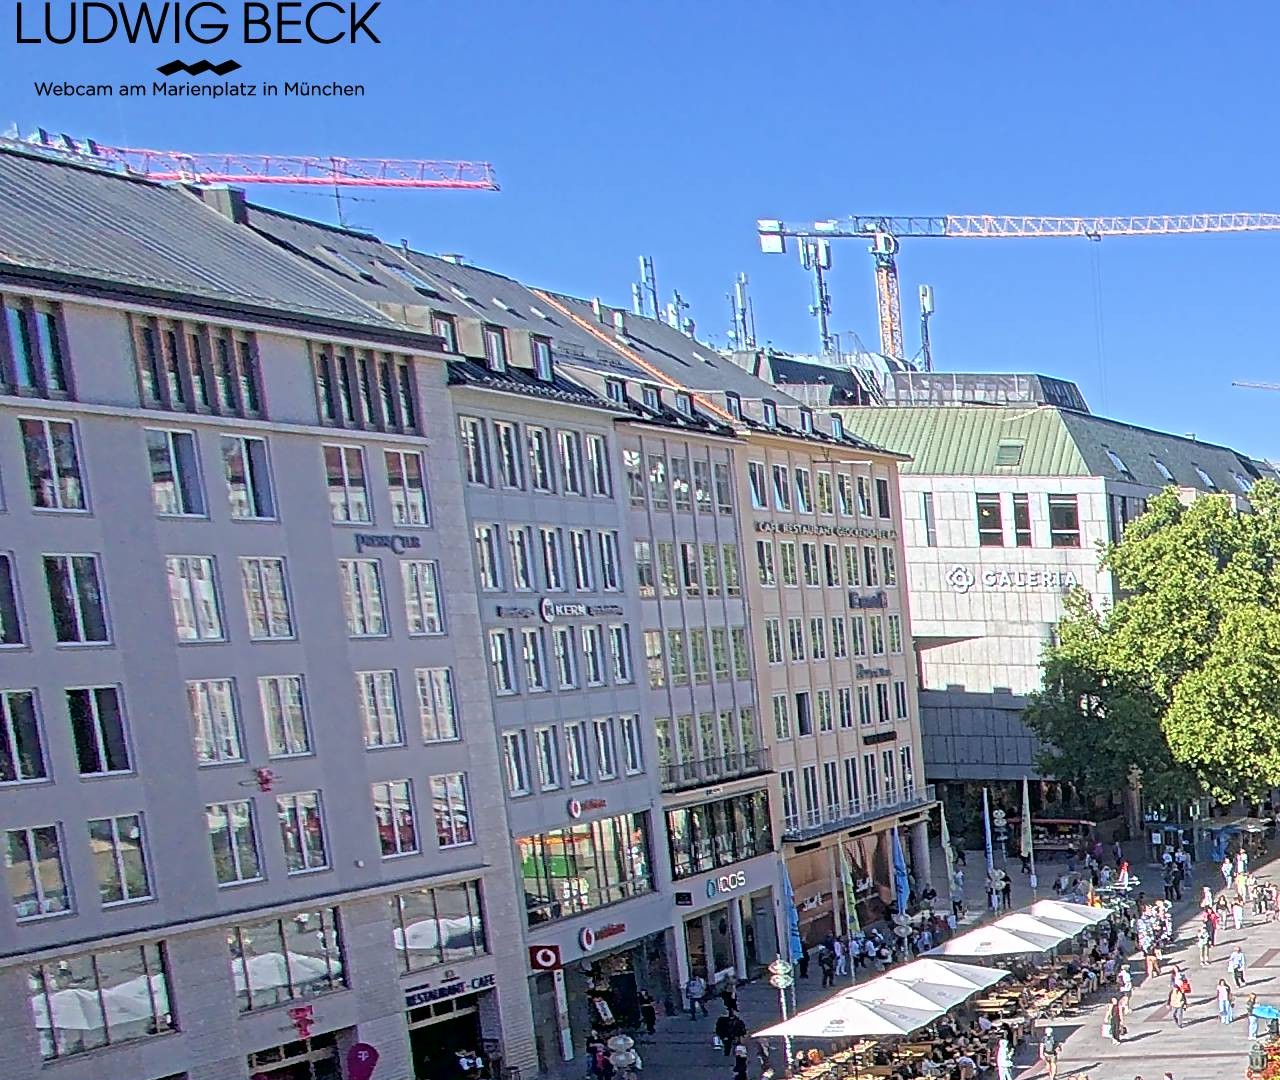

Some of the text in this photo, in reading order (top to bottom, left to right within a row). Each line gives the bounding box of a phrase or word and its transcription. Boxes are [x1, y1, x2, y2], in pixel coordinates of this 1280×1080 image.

[982, 570, 1077, 588] GALERIA
[555, 603, 588, 616] KERN
[717, 871, 746, 893] IQOS
[405, 981, 466, 1008] RESTAURANT
